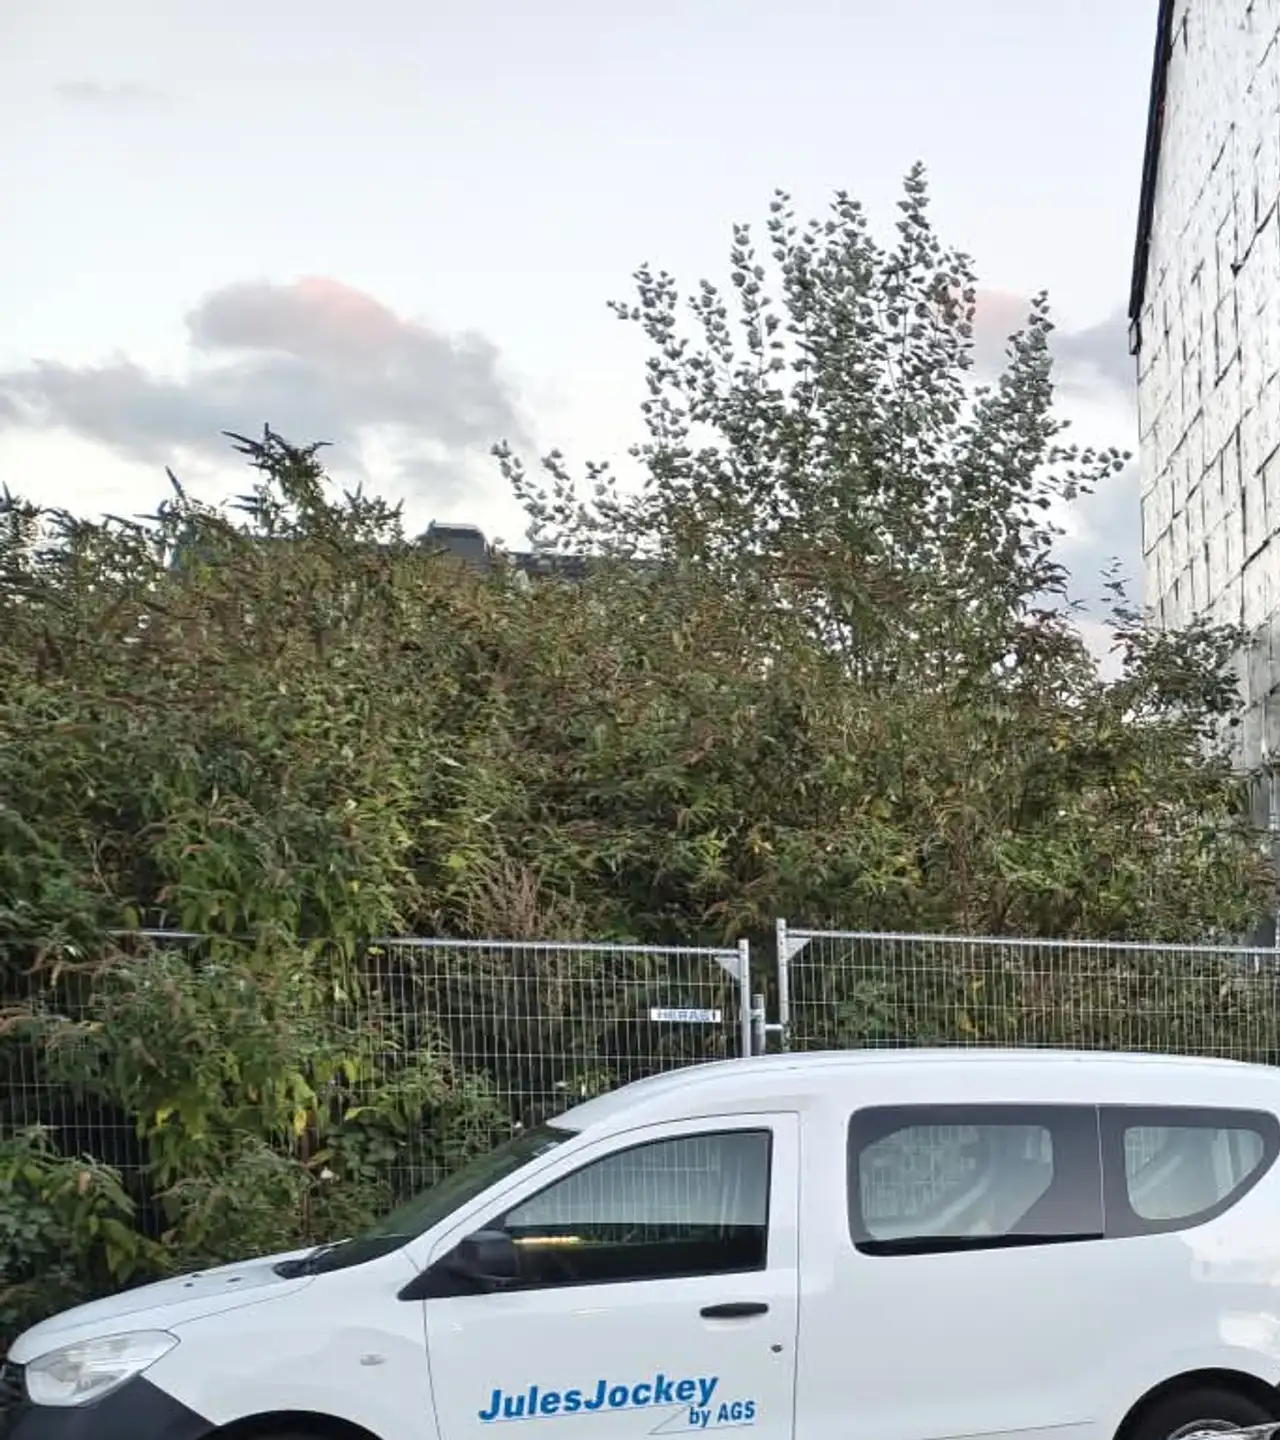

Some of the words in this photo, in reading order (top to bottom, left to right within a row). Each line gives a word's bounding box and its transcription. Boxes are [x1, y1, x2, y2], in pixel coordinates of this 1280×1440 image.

[478, 1373, 719, 1421] JulesJockey
[689, 1405, 711, 1427] by
[717, 1400, 755, 1423] AGS
